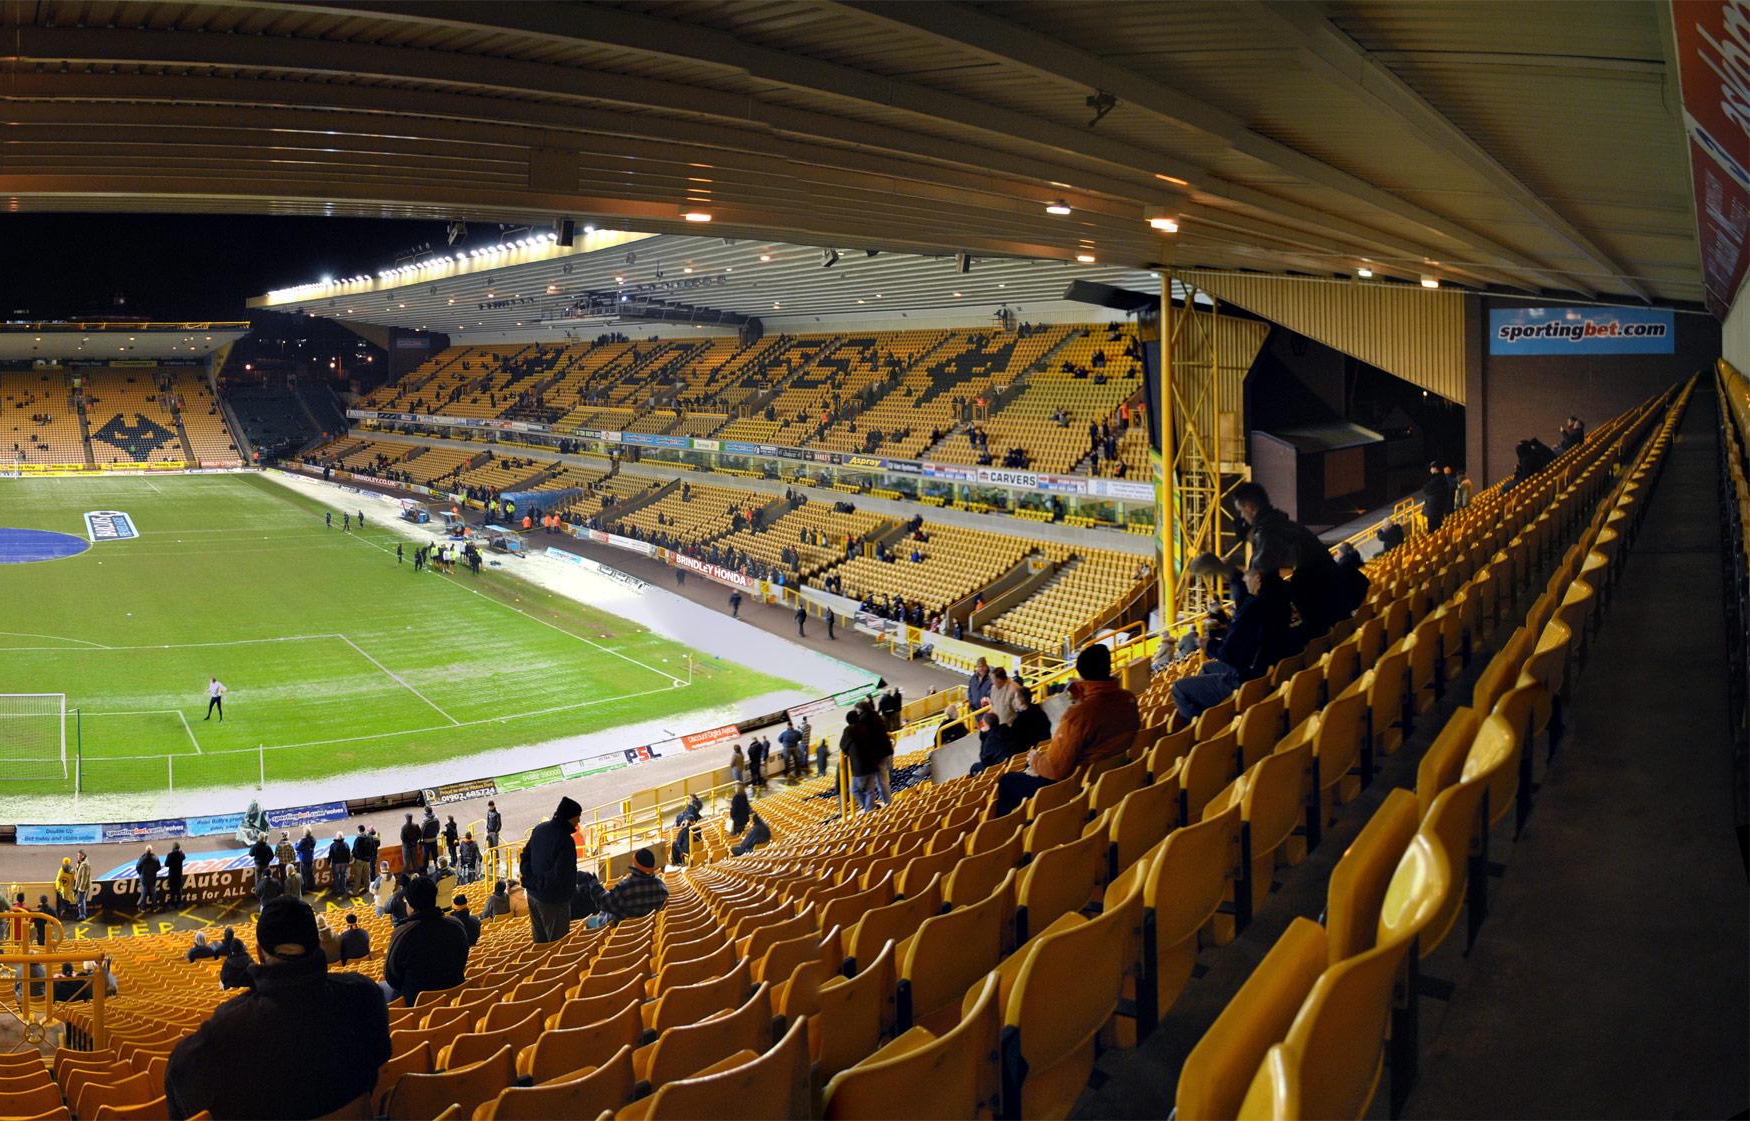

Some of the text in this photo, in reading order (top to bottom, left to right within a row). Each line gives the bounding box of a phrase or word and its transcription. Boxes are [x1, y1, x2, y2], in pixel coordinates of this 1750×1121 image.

[1497, 320, 1667, 341] sportingbet.com
[850, 456, 882, 467] Aspray
[354, 473, 396, 486] BRINDLEY.CO.UK
[990, 472, 1035, 487] CARVERS
[676, 554, 747, 586] BRINDLEY HONDA
[625, 745, 661, 765] PSL
[271, 808, 344, 823] sportingbet.com/wolves
[107, 825, 184, 838] sportingbet.com/wolves
[182, 871, 233, 890] Auto
[202, 890, 220, 900] for
[223, 886, 246, 897] ALL
[74, 921, 175, 941] KEEP
